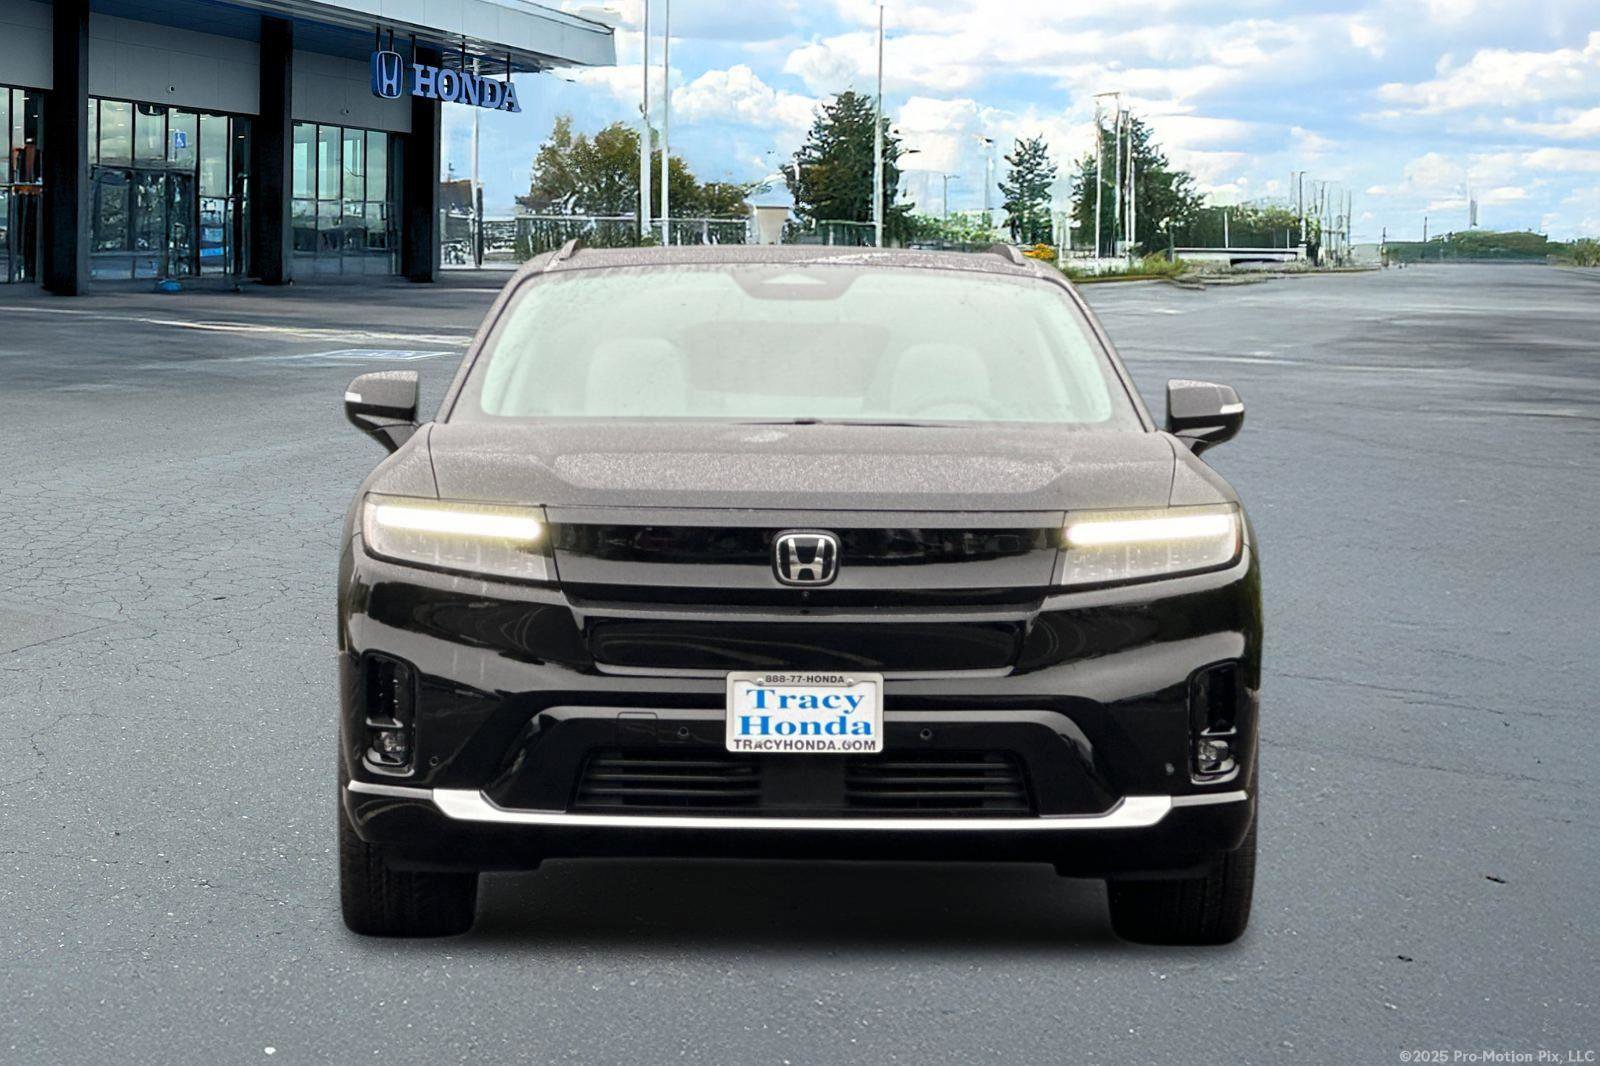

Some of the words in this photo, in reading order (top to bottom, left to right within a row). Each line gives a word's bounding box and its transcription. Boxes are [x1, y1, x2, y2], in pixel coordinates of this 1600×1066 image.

[411, 63, 522, 113] HONDA
[765, 675, 845, 684] 888-77-HONDA
[746, 689, 865, 714] Tracy
[738, 715, 873, 736] Honda
